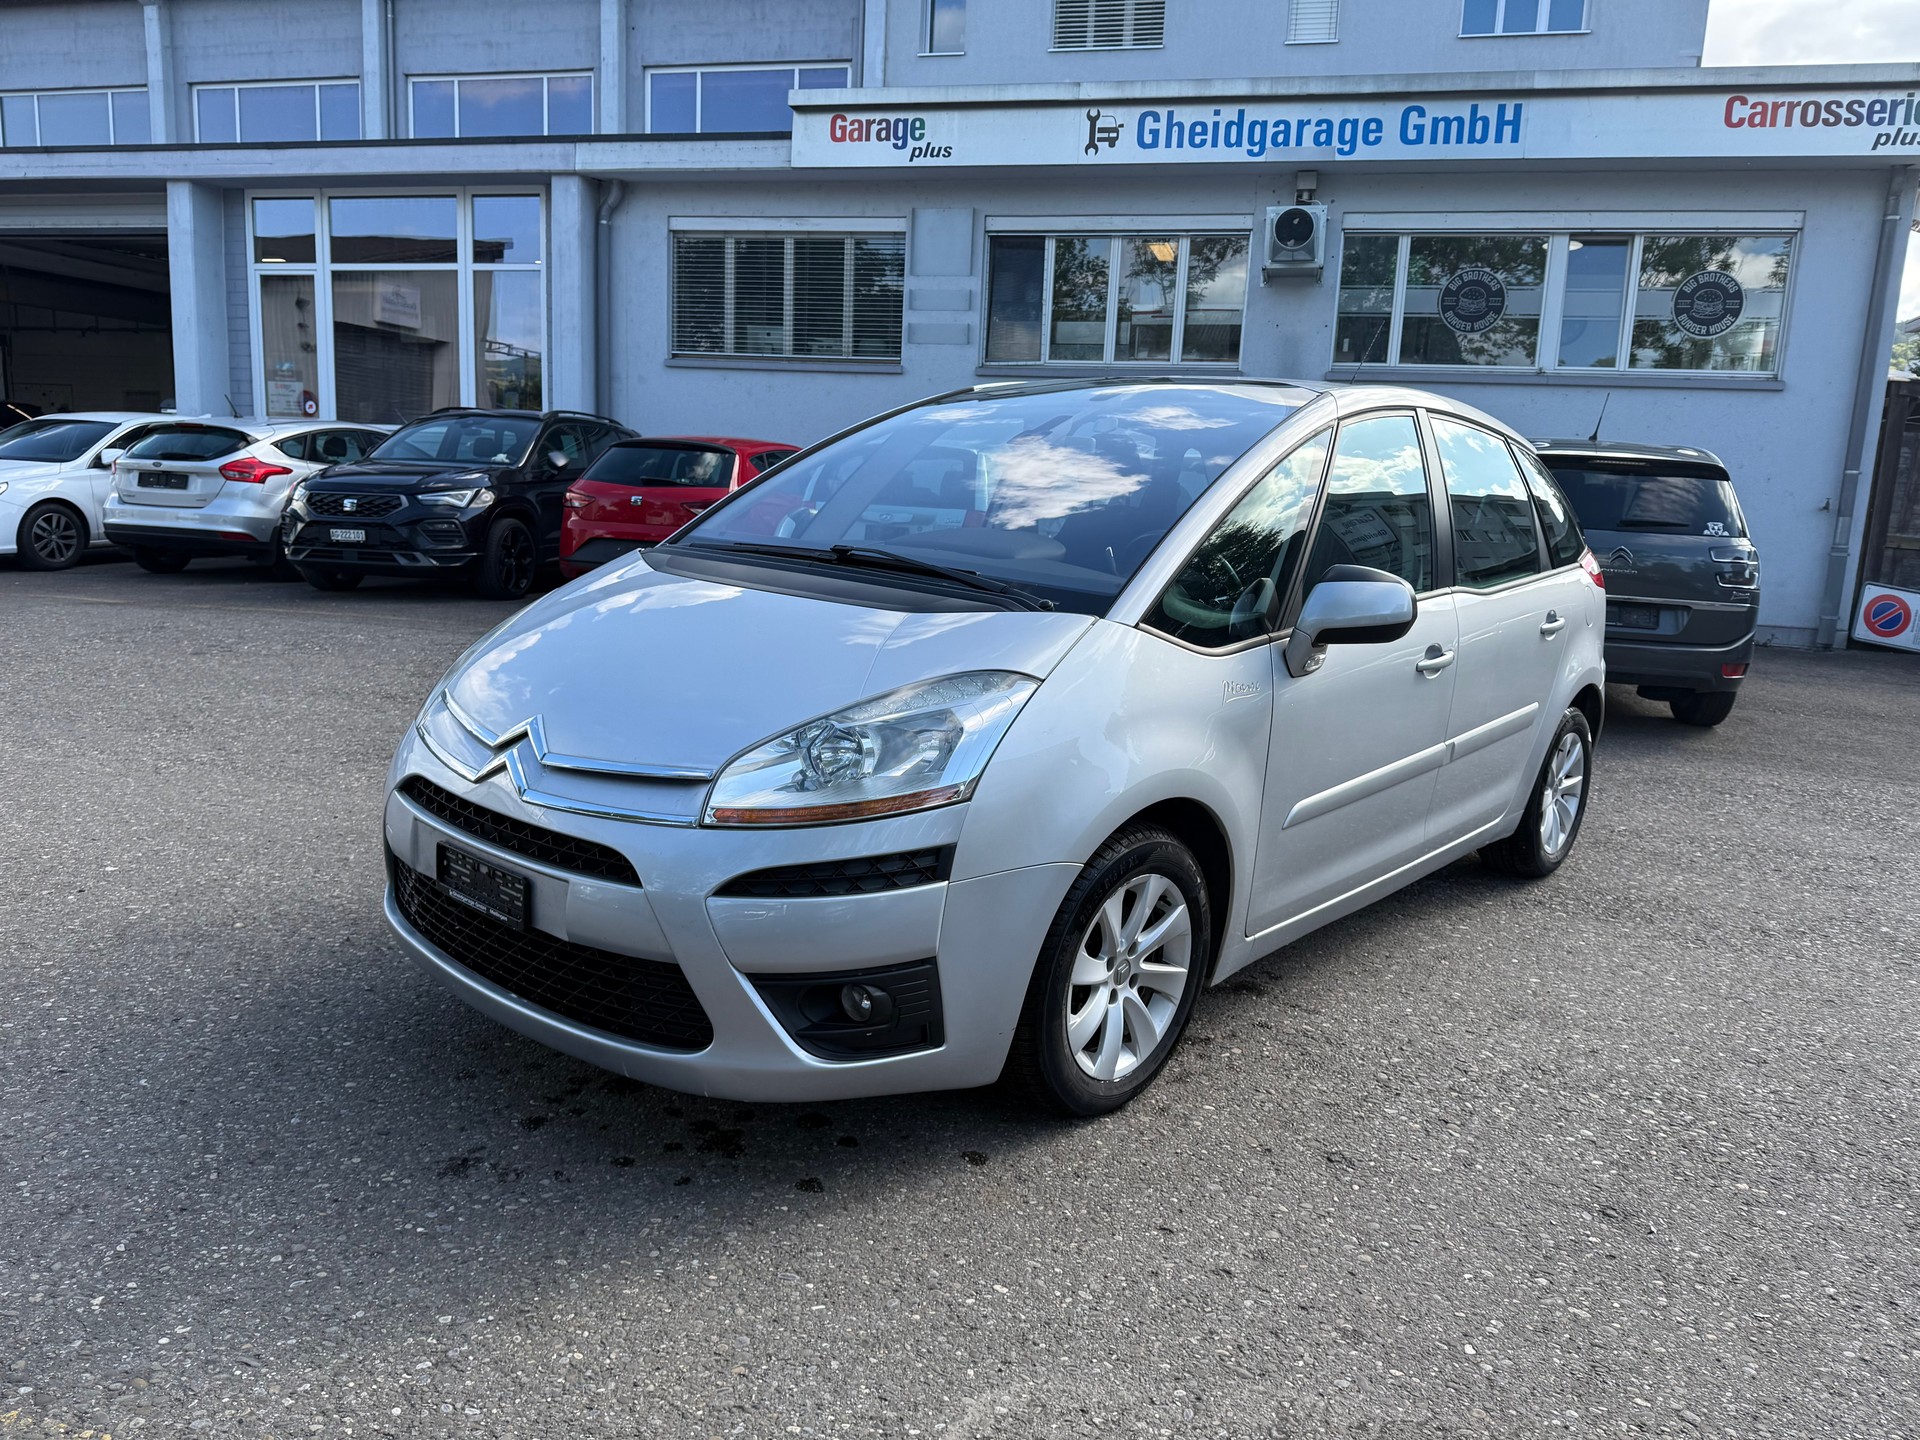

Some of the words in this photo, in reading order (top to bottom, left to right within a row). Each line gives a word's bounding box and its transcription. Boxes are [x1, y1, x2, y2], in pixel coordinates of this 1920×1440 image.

[830, 113, 926, 150] Garage
[1136, 108, 1384, 158] Gheidgarage
[1399, 102, 1523, 146] GmbH
[1871, 127, 1920, 151] plu
[909, 142, 953, 163] plus
[1448, 277, 1463, 291] BIG
[1462, 271, 1501, 291] BROTHERS
[1682, 278, 1698, 293] BIG
[1697, 272, 1739, 294] BROTHERS
[1444, 310, 1472, 331] BURGER
[1473, 310, 1499, 331] HOUSE
[1678, 313, 1708, 335] BURGER
[1709, 313, 1736, 334] HOUSE
